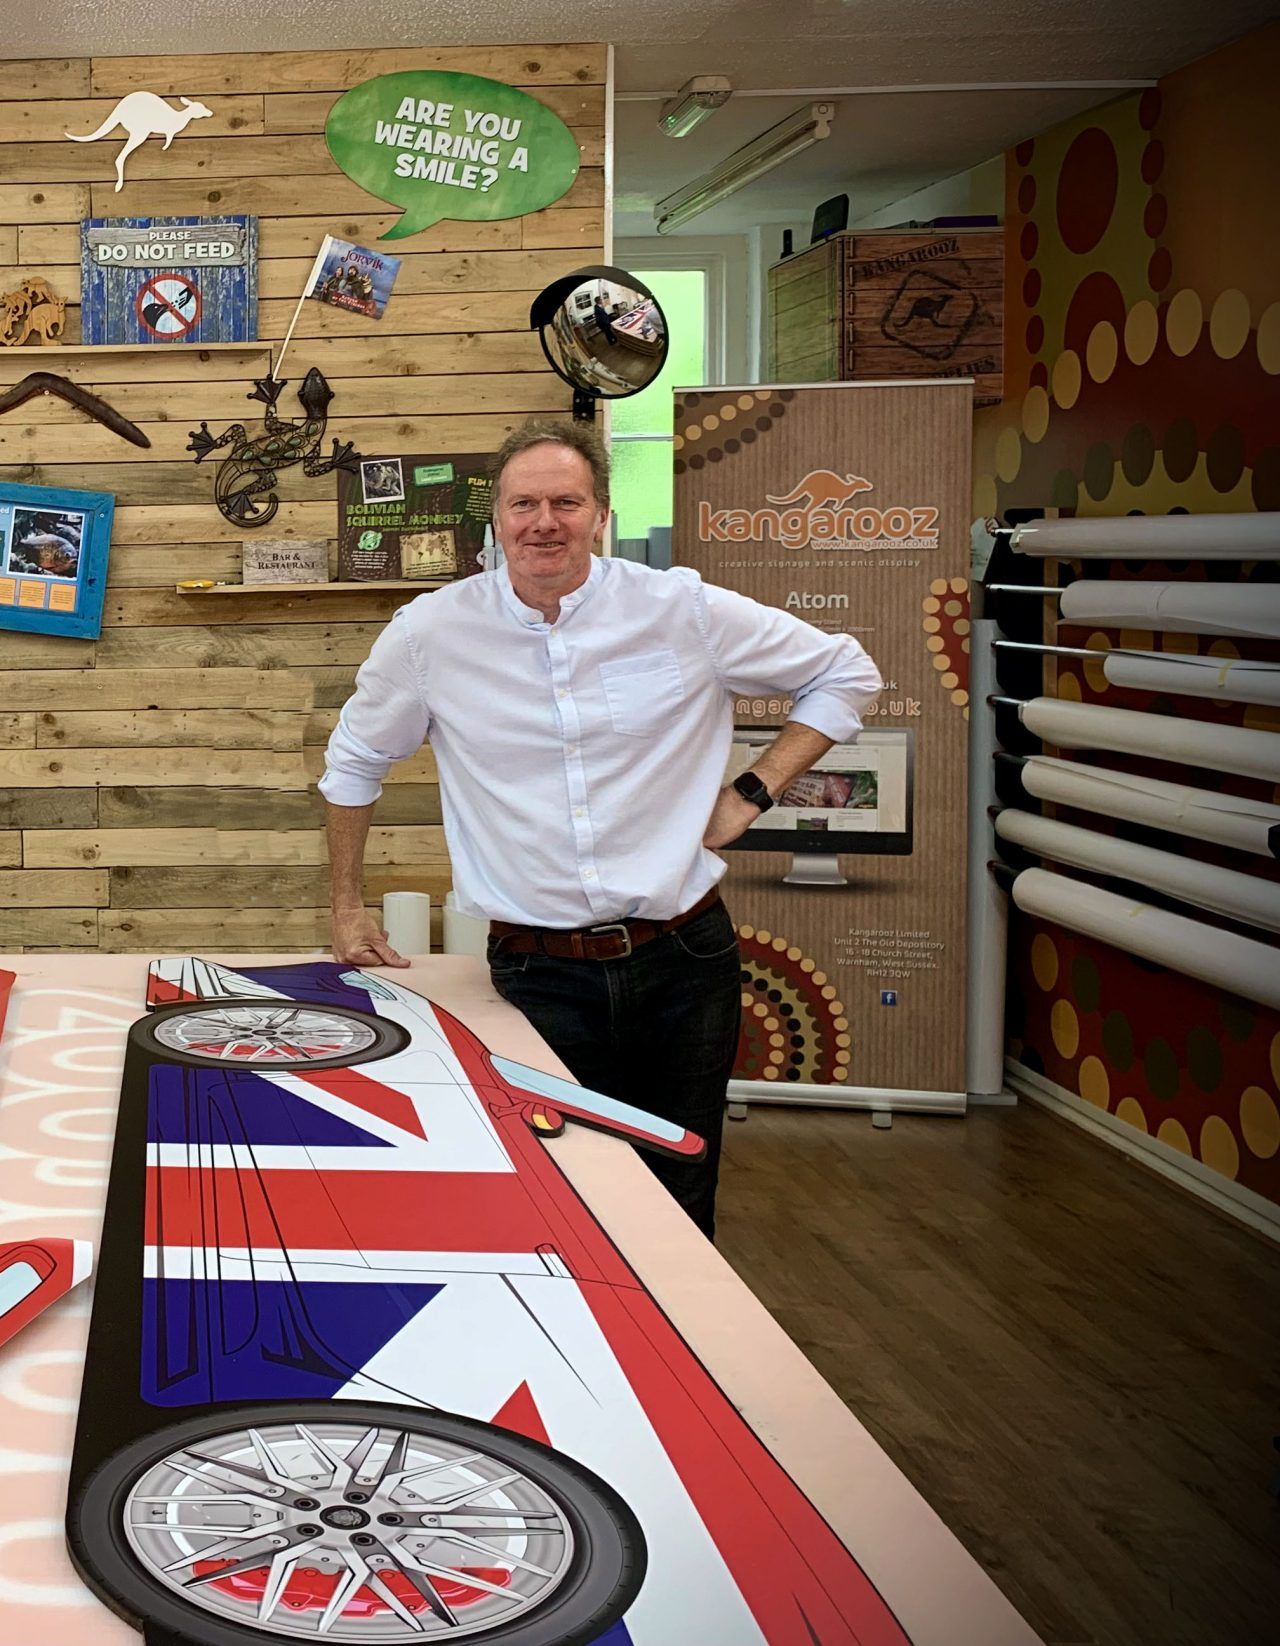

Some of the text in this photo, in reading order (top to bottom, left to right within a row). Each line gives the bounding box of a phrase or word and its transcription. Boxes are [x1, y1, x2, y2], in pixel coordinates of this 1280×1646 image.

[395, 96, 521, 141] ARE YOU
[374, 120, 528, 173] WEARING A
[394, 153, 499, 193] SMILE?
[149, 231, 192, 240] PLEASE
[98, 242, 235, 261] DO NOT FEED
[346, 504, 406, 514] BOLIVIAN
[346, 514, 464, 526] SQUIRREL MONKEY
[698, 502, 940, 550] kangarooz
[811, 539, 939, 550] www.kangarooz.co.uk
[292, 552, 300, 560] &
[258, 562, 316, 570] RESTAURANT
[770, 560, 810, 569] signage
[878, 559, 920, 568] display
[785, 591, 850, 609] Atom
[849, 928, 930, 938] Kangarooz Limited
[862, 938, 877, 946] The
[880, 938, 895, 946] Old
[896, 939, 945, 950] Depository
[872, 949, 902, 958] Church
[882, 960, 904, 968] West
